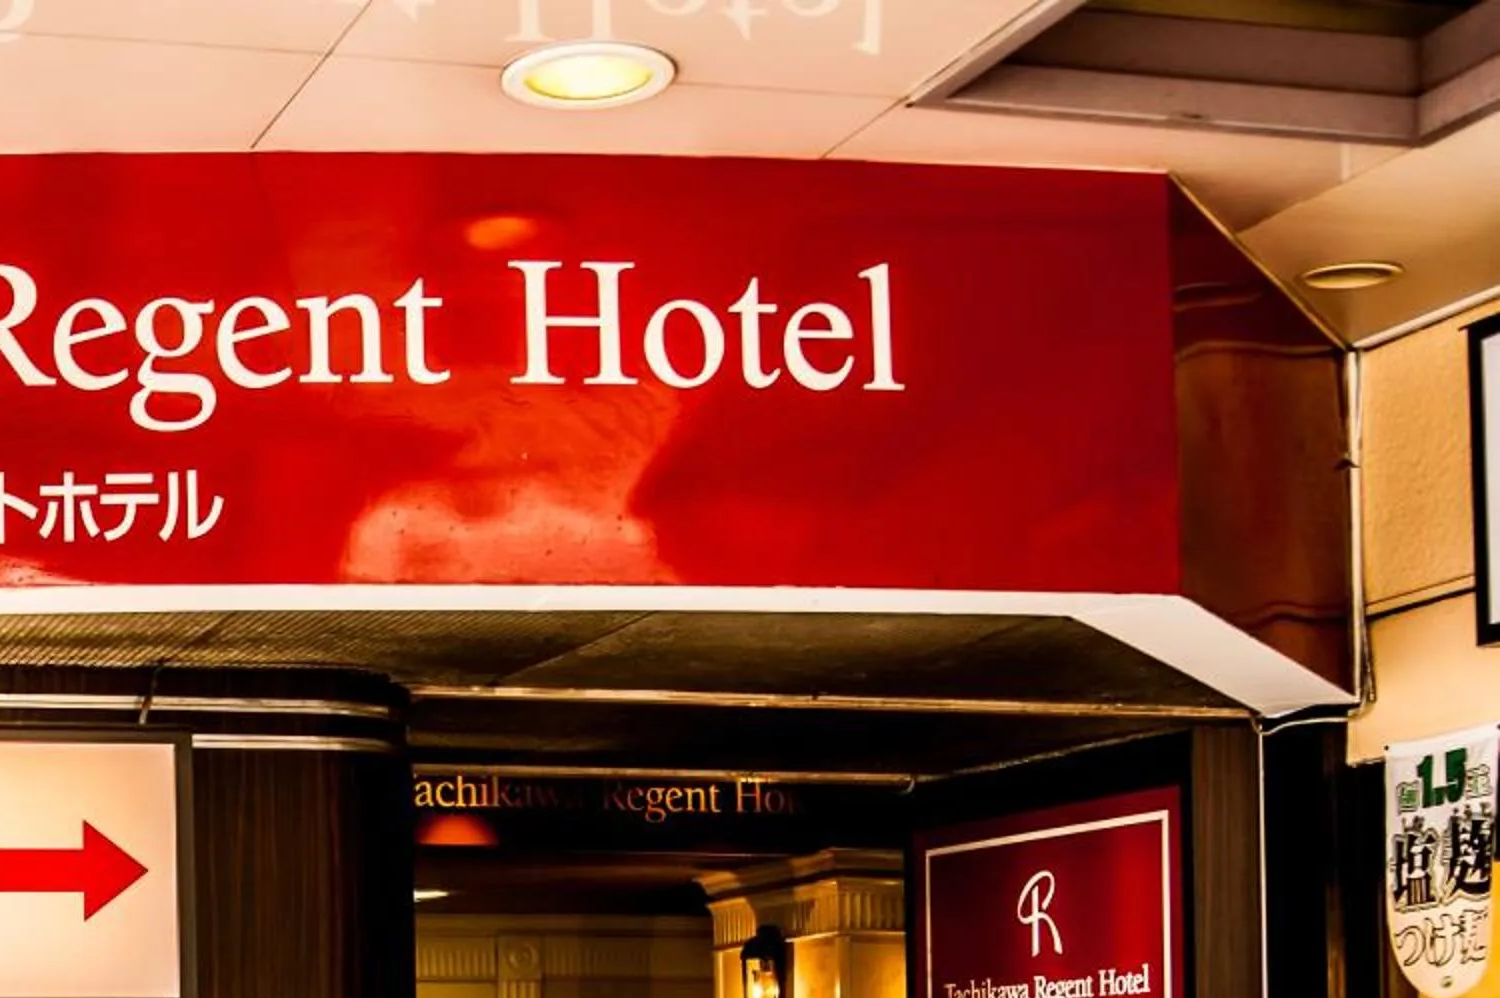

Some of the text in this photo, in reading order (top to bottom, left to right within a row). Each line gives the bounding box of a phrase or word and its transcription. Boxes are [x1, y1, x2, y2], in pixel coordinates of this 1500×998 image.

[508, 260, 905, 391] Hotel
[601, 780, 723, 822] Regent
[1098, 963, 1150, 997] Hotel
